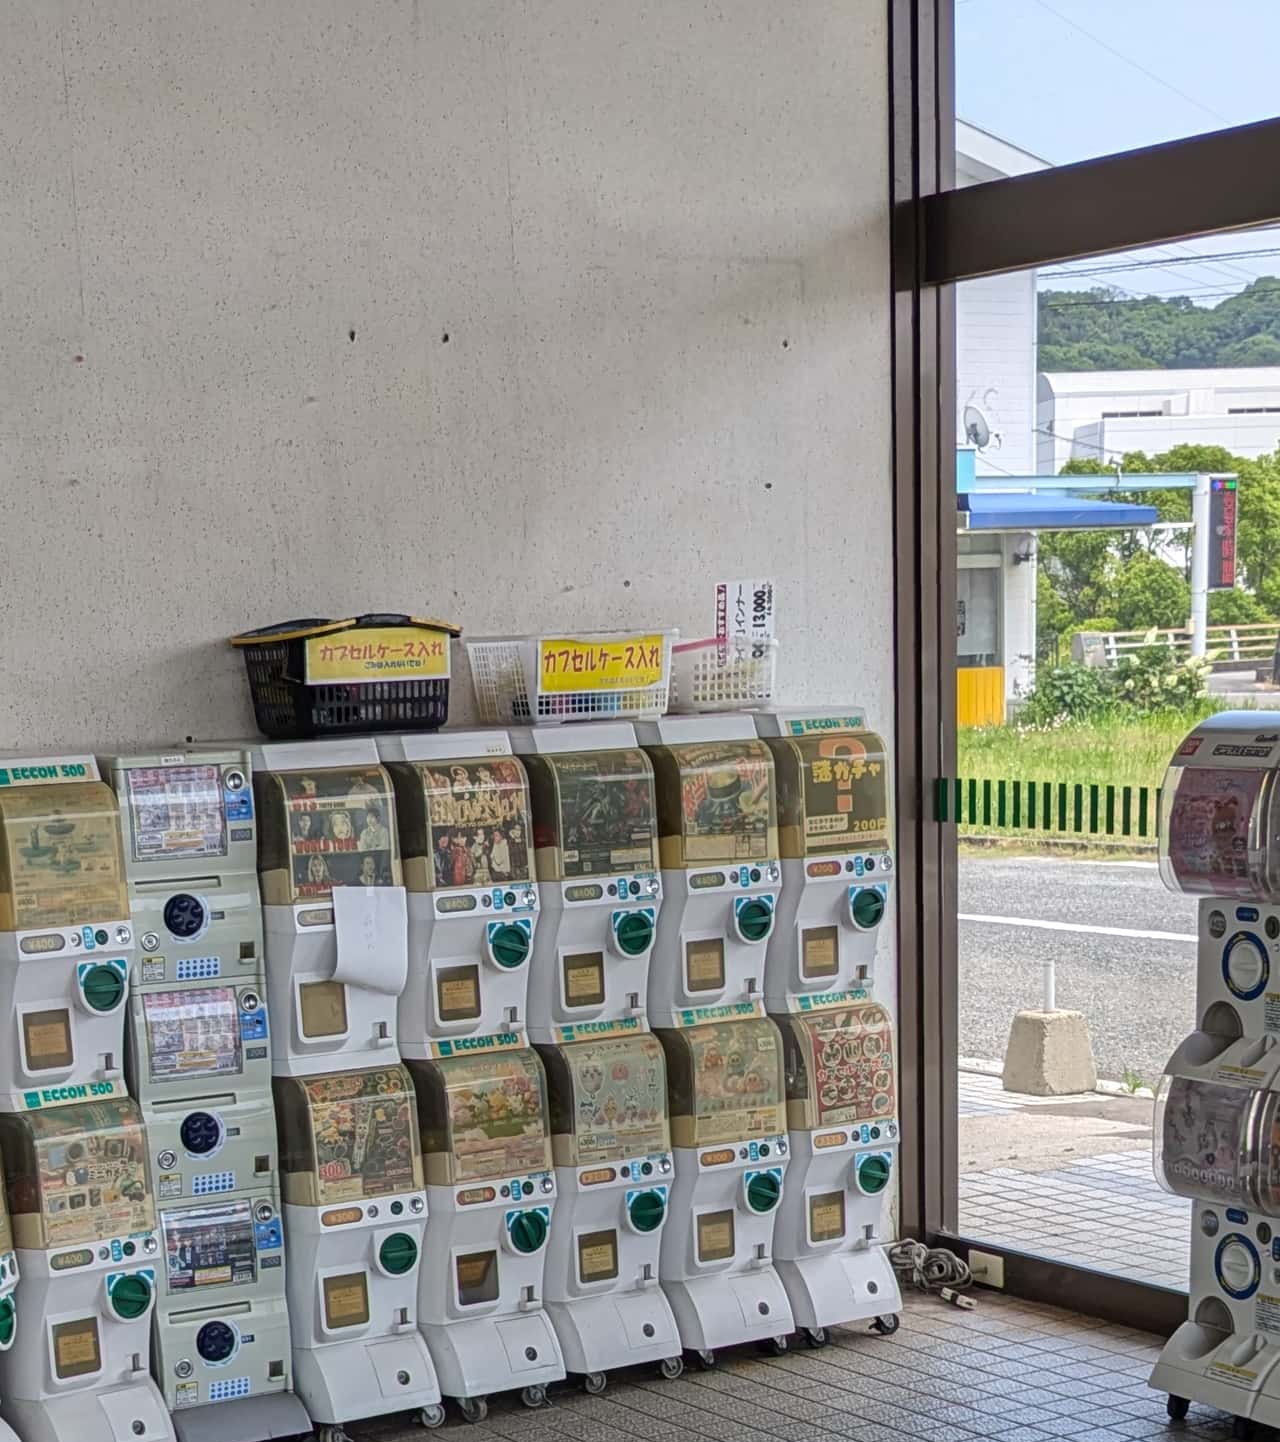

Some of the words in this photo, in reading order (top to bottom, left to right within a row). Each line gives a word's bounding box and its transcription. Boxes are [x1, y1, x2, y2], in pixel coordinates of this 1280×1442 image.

[60, 763, 86, 777] 500
[496, 1031, 519, 1046] 500
[90, 1081, 114, 1096] 500
